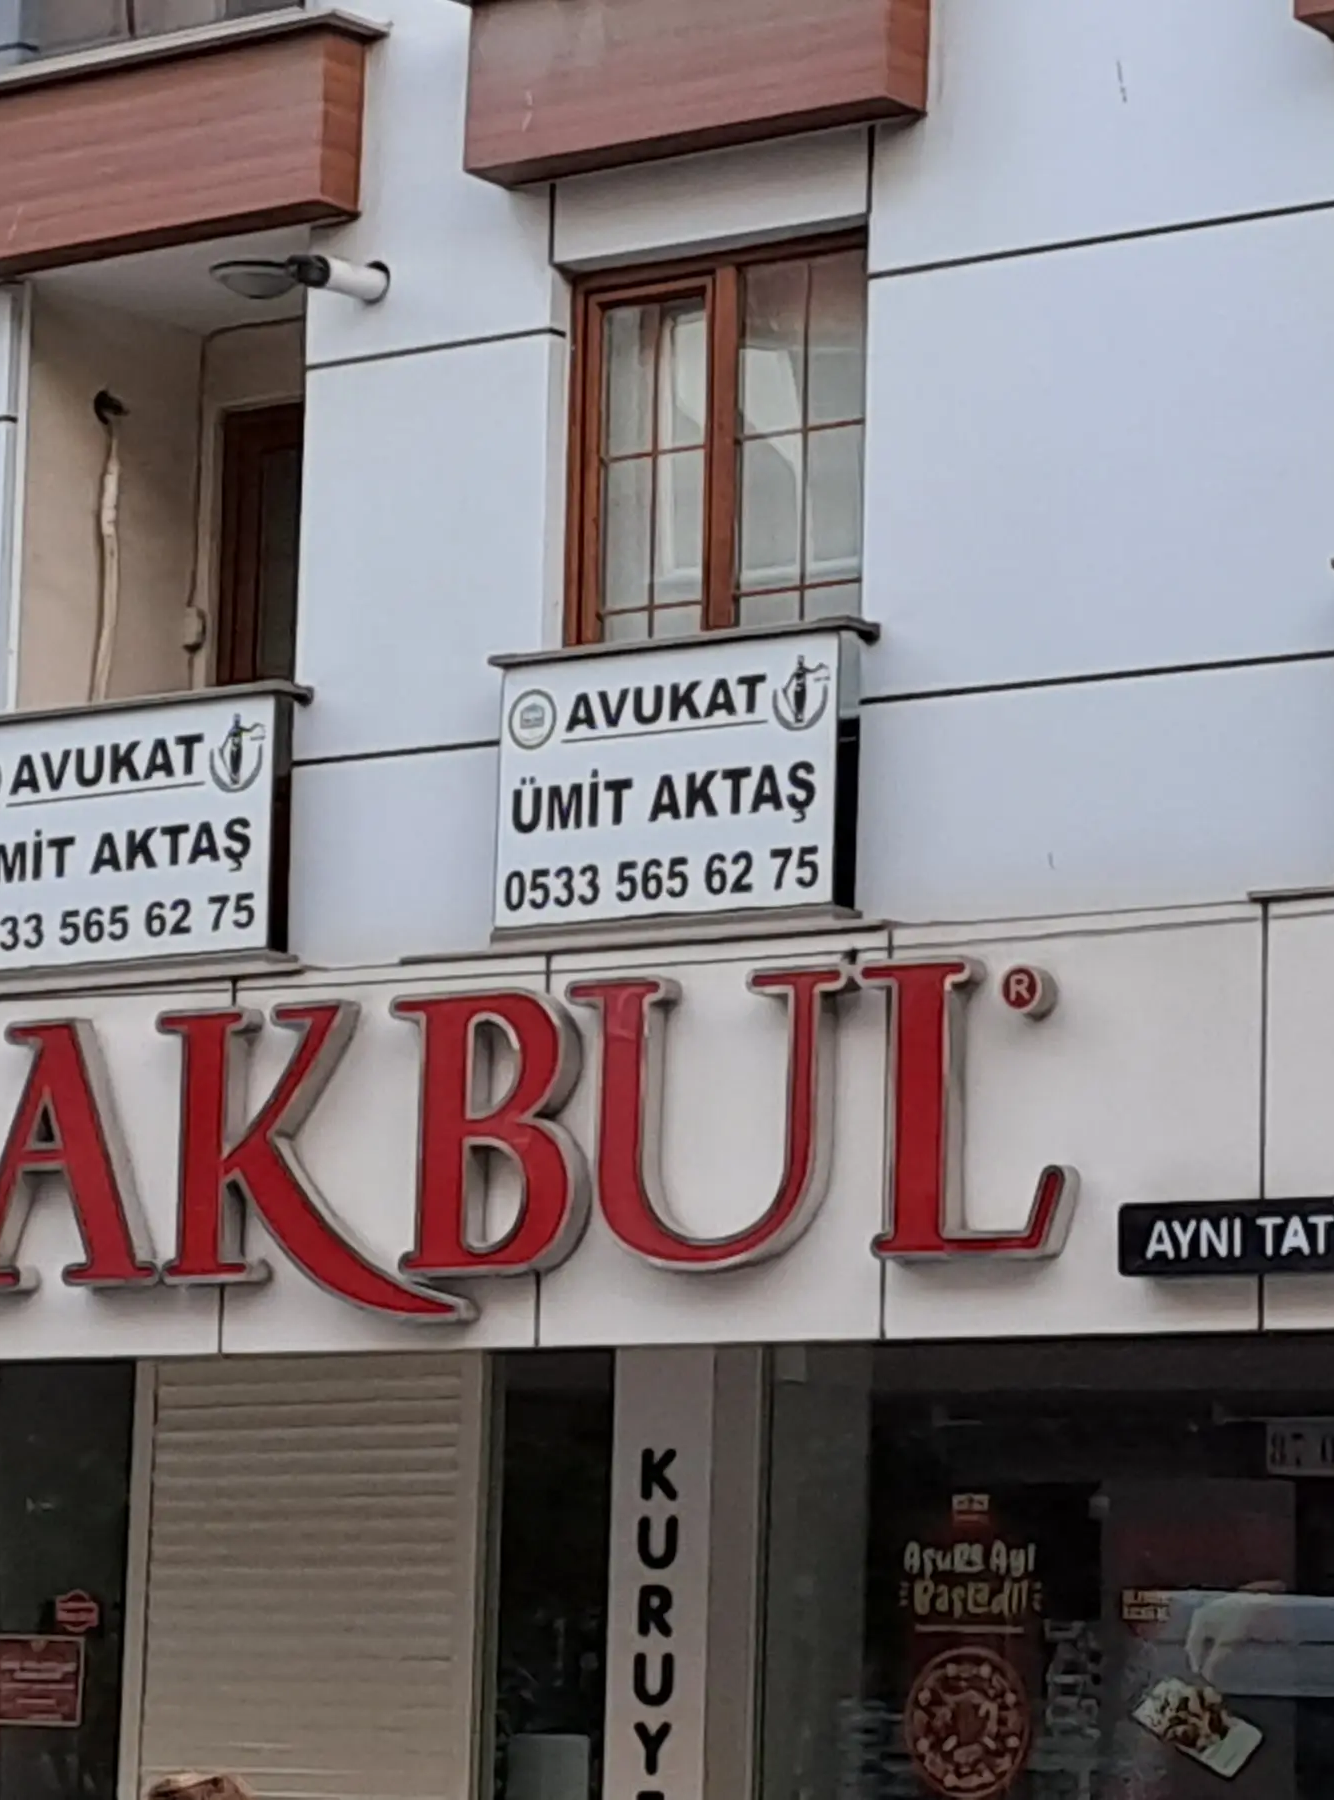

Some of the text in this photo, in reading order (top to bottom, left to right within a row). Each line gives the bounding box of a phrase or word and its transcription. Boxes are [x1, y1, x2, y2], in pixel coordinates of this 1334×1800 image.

[565, 674, 766, 733] AVUKAT
[9, 733, 204, 795] AVUKAT
[512, 761, 816, 834] ÜMİT AKTAŞ
[90, 817, 251, 872] AKTAŞ
[504, 845, 819, 911] 0533 565 62 75
[59, 905, 129, 946] 565
[145, 899, 192, 937] 62
[207, 892, 256, 933] 75
[1145, 1220, 1242, 1260] AYNI
[633, 1447, 679, 1800] KURUY
